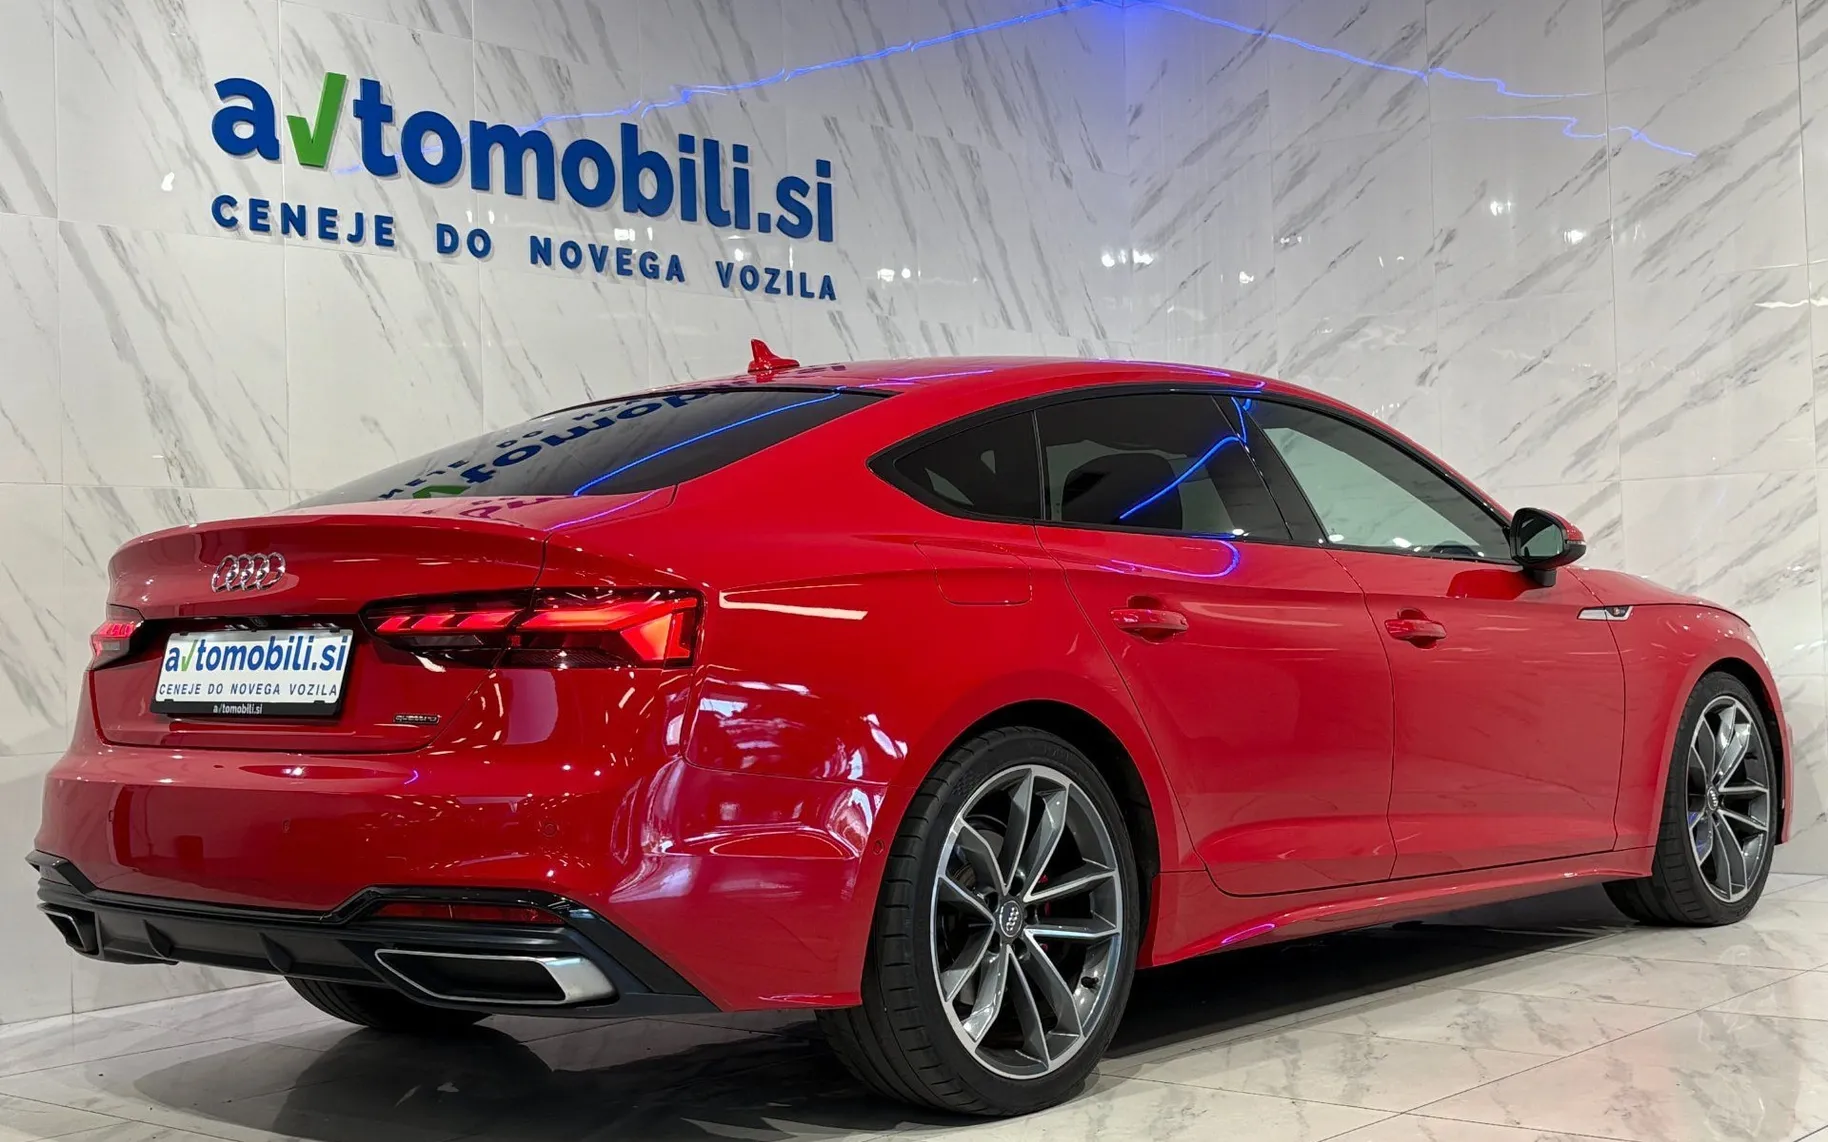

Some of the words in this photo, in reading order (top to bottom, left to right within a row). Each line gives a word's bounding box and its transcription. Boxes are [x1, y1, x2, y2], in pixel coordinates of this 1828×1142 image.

[211, 71, 834, 242] avtomobili.si
[211, 194, 396, 248] CENEJE
[436, 223, 493, 259] DO
[529, 235, 686, 283] NOVEGA
[715, 260, 837, 301] VOZILA
[159, 682, 202, 695] CENEJE
[208, 683, 223, 695] DO
[230, 683, 280, 695] NOVEGA
[288, 683, 338, 696] VOZILA
[165, 635, 348, 672] avtomobili.si
